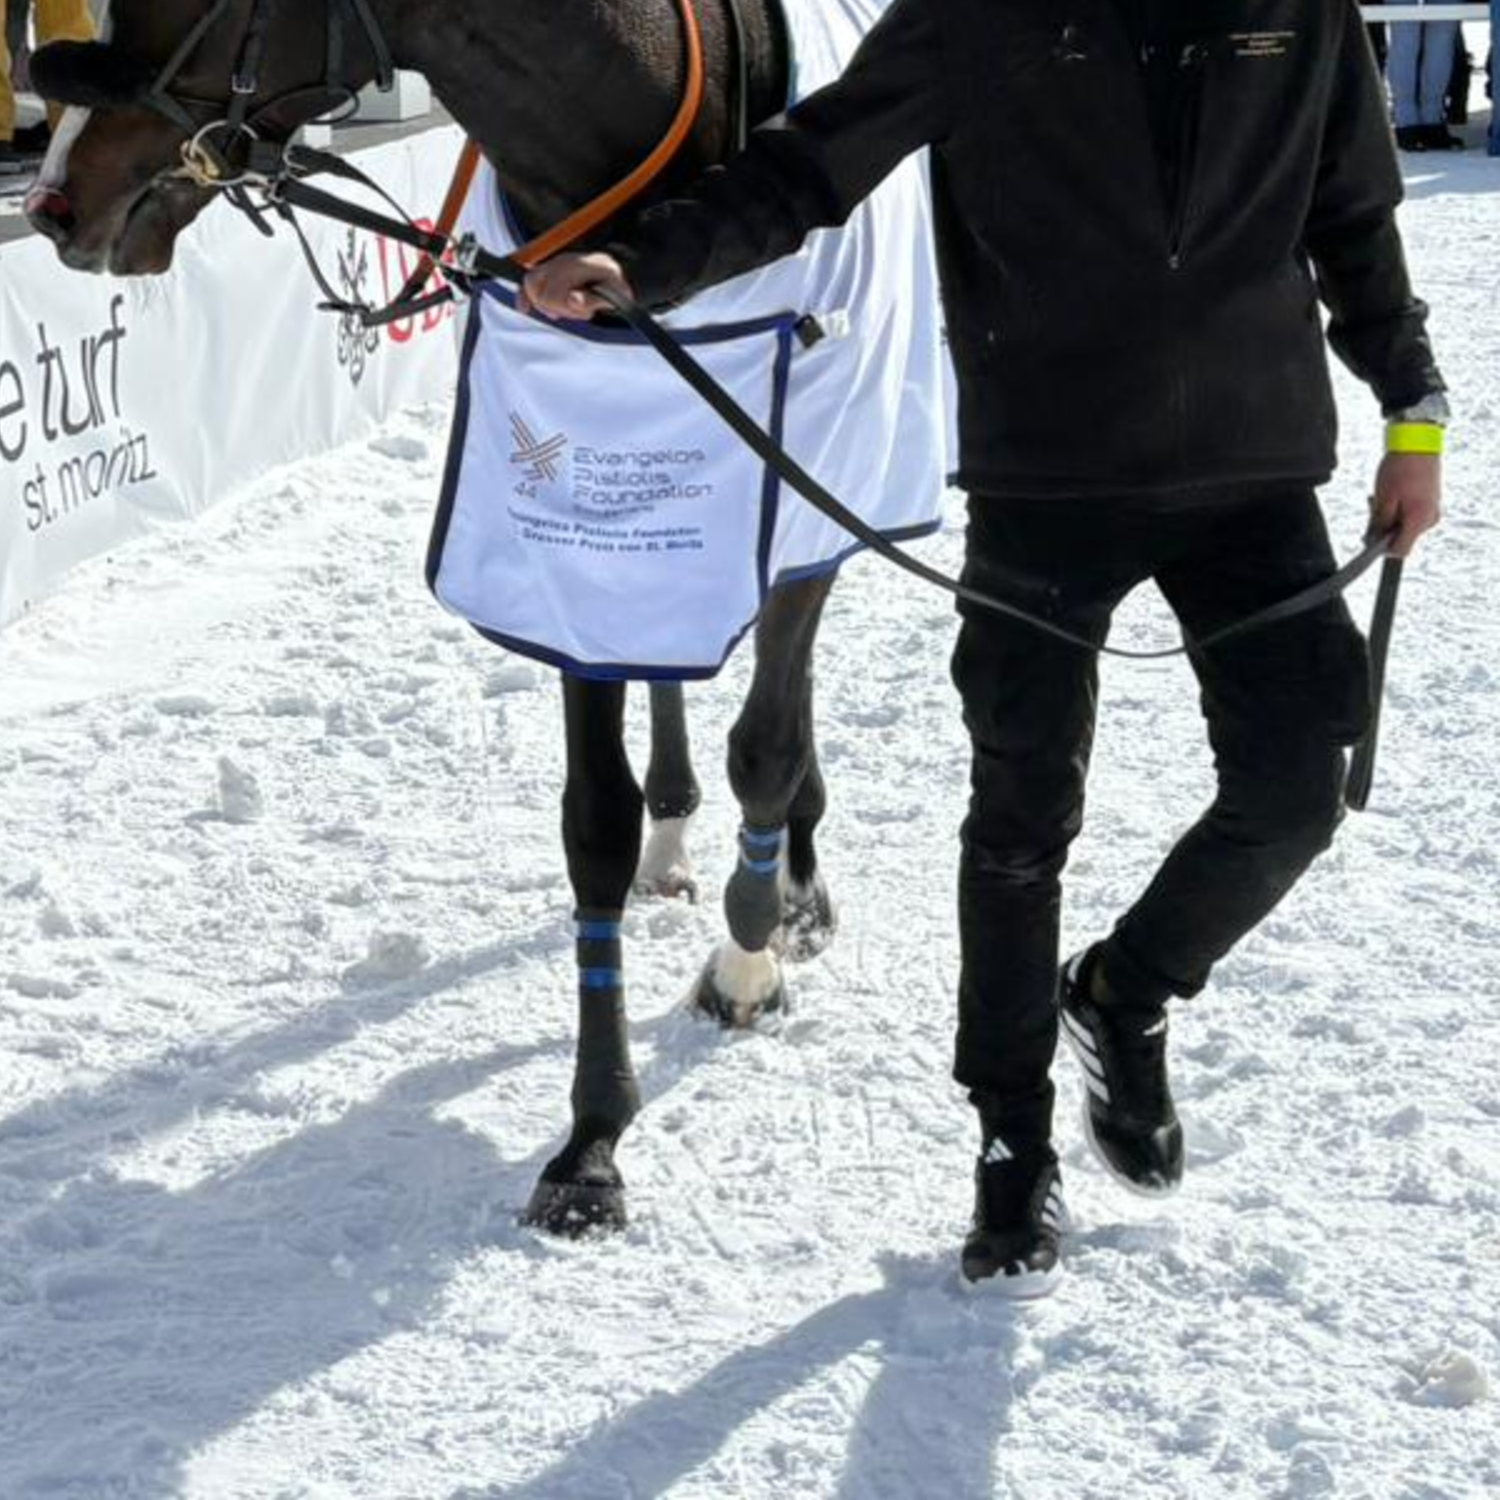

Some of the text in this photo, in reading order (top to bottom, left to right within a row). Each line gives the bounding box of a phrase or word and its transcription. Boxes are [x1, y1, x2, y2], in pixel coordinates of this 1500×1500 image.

[36, 293, 126, 442] turf
[573, 446, 706, 468] Evangelos
[573, 483, 714, 505] Foundation
